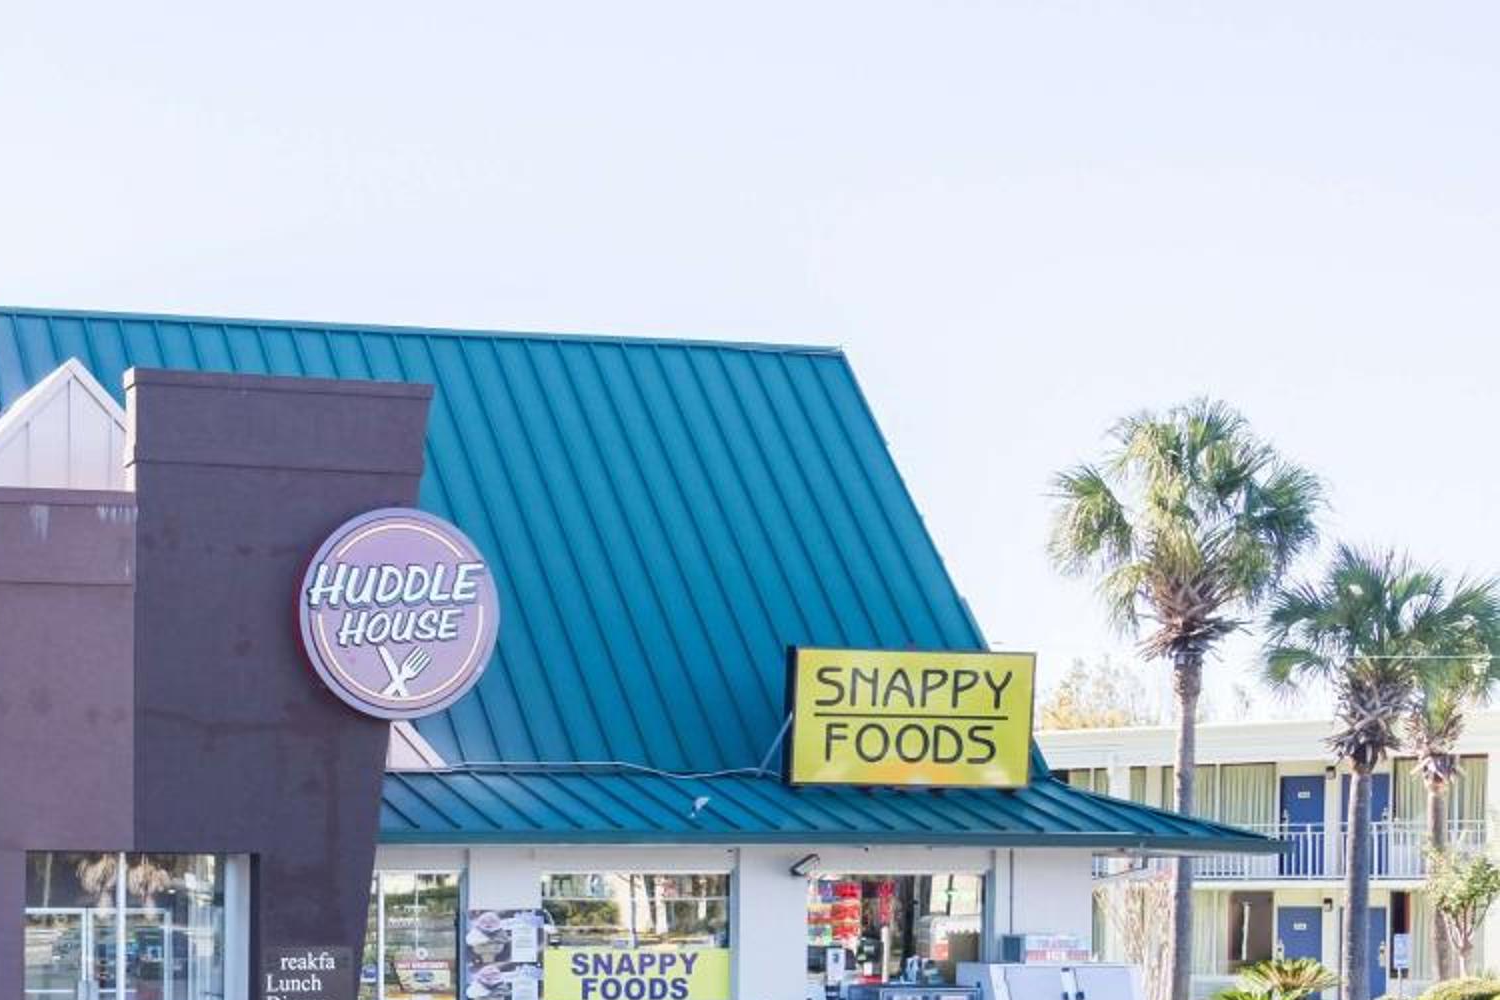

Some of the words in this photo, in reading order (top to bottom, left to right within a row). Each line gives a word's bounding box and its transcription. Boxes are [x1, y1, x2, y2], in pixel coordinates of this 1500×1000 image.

[308, 563, 485, 608] HUDDLE
[338, 609, 463, 647] HOUSE
[815, 666, 1013, 710] SNAPPY
[825, 723, 997, 765] FOODS
[266, 973, 322, 993] Lunch
[571, 953, 699, 977] SNAPPY
[581, 978, 690, 1000] FOODS
